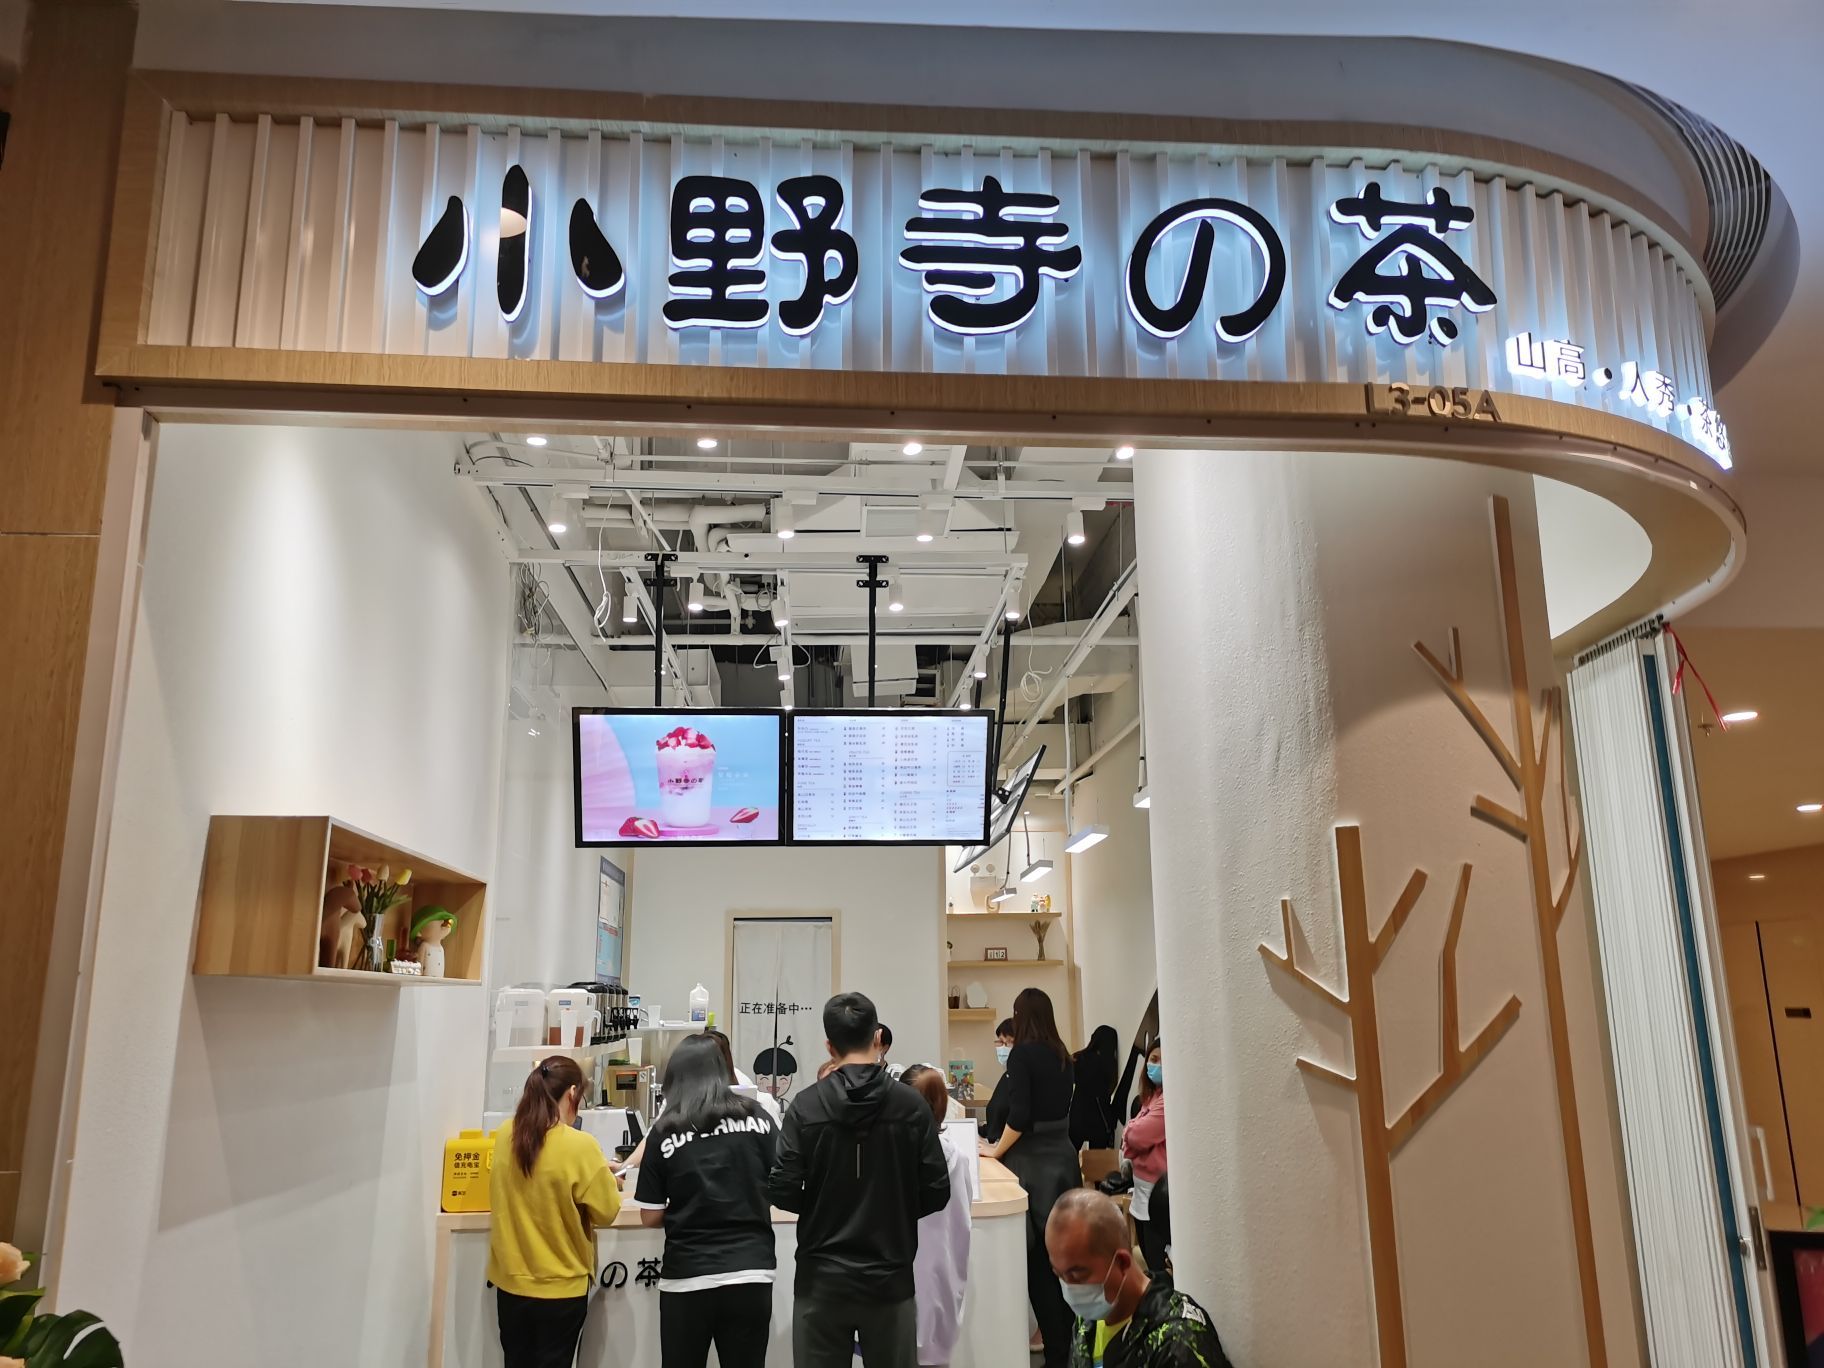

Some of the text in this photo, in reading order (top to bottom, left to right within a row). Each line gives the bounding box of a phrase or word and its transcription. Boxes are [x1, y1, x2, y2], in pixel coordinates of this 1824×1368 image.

[411, 163, 1498, 347] 小野寺の茶
[1364, 381, 1502, 422] L3-05A
[454, 1152, 480, 1162] 免押金
